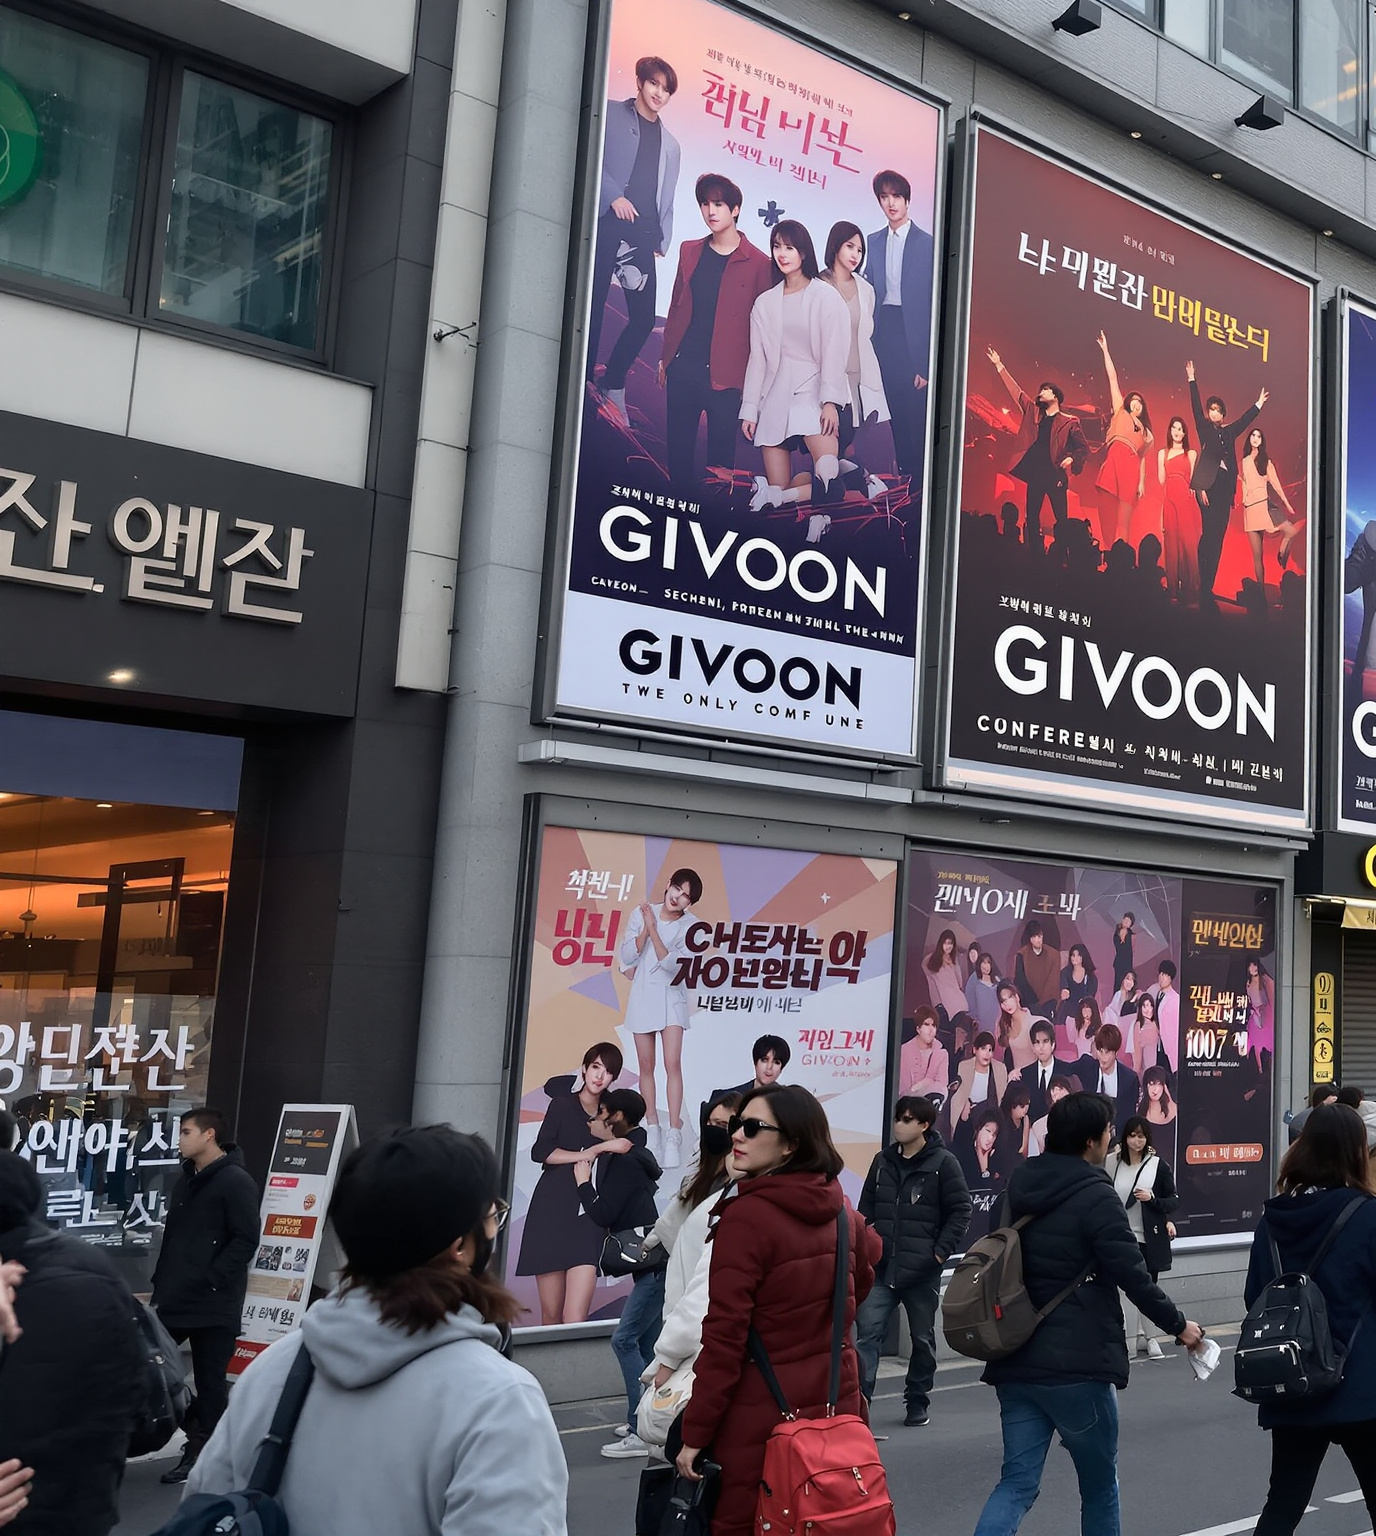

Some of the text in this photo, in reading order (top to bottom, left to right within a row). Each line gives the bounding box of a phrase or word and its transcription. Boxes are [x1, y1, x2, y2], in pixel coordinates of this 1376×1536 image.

[599, 505, 888, 619] GIVOON
[618, 628, 863, 711] GIVOON
[683, 693, 738, 711] ONLY
[754, 703, 812, 721] COMF
[825, 714, 864, 730] UNE
[994, 624, 1277, 744] GIVOON
